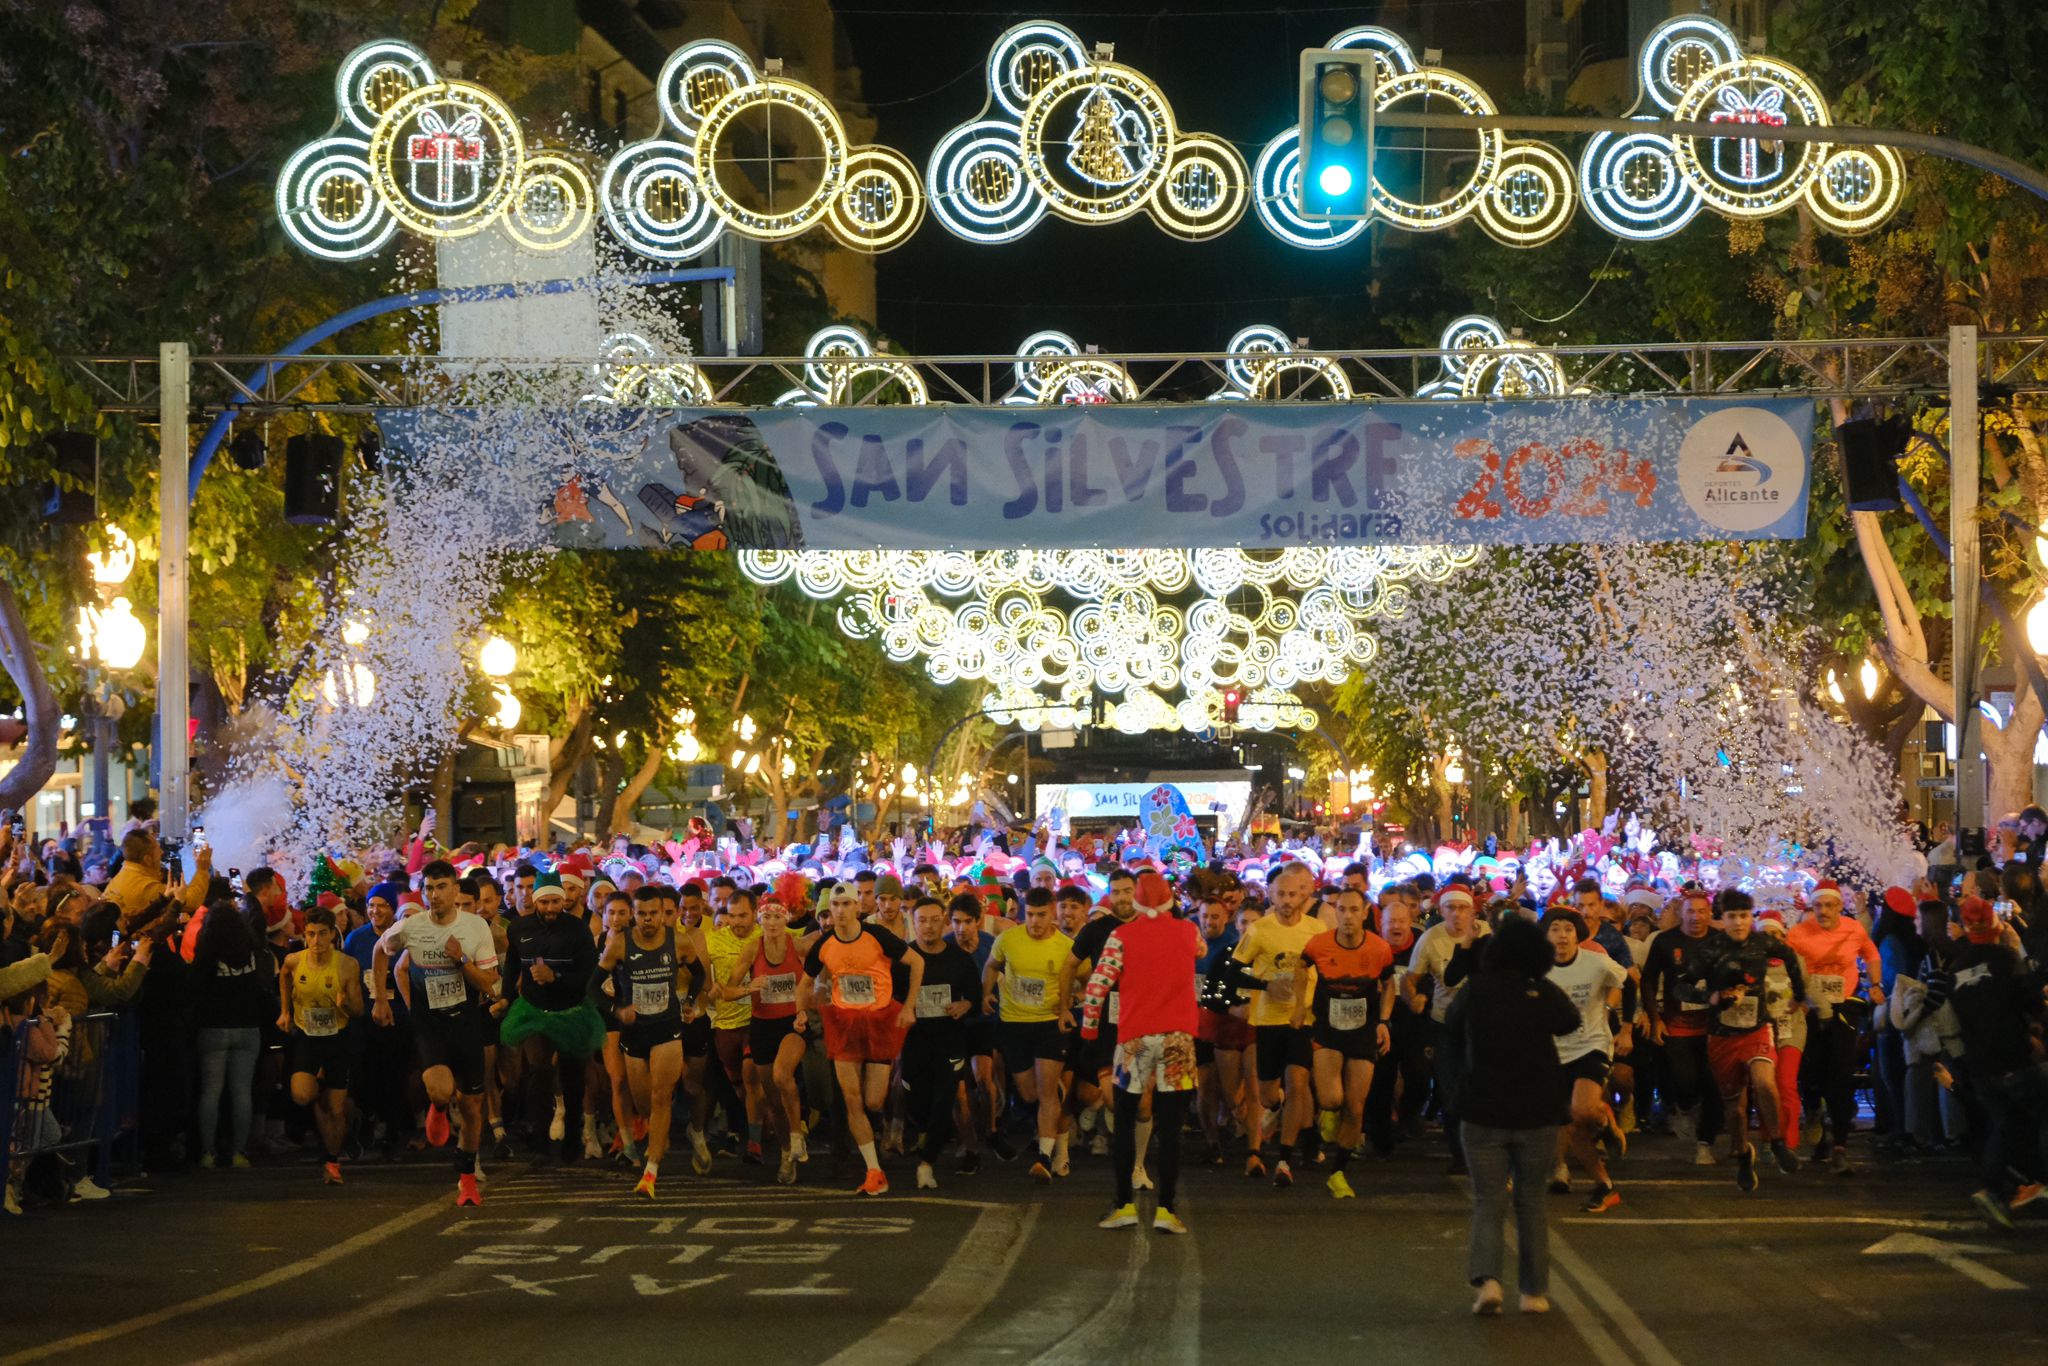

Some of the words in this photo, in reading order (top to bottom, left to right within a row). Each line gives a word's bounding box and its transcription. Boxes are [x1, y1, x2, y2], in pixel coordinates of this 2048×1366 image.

[810, 421, 968, 519] SAN
[1454, 437, 1657, 518] 2024
[1704, 488, 1779, 502] Alicante
[1095, 792, 1118, 807] SAN
[439, 980, 462, 997] 2739
[850, 981, 871, 993] 1024
[932, 991, 943, 1005] 77
[440, 1217, 916, 1235] SOLO
[454, 1244, 843, 1264] BUS
